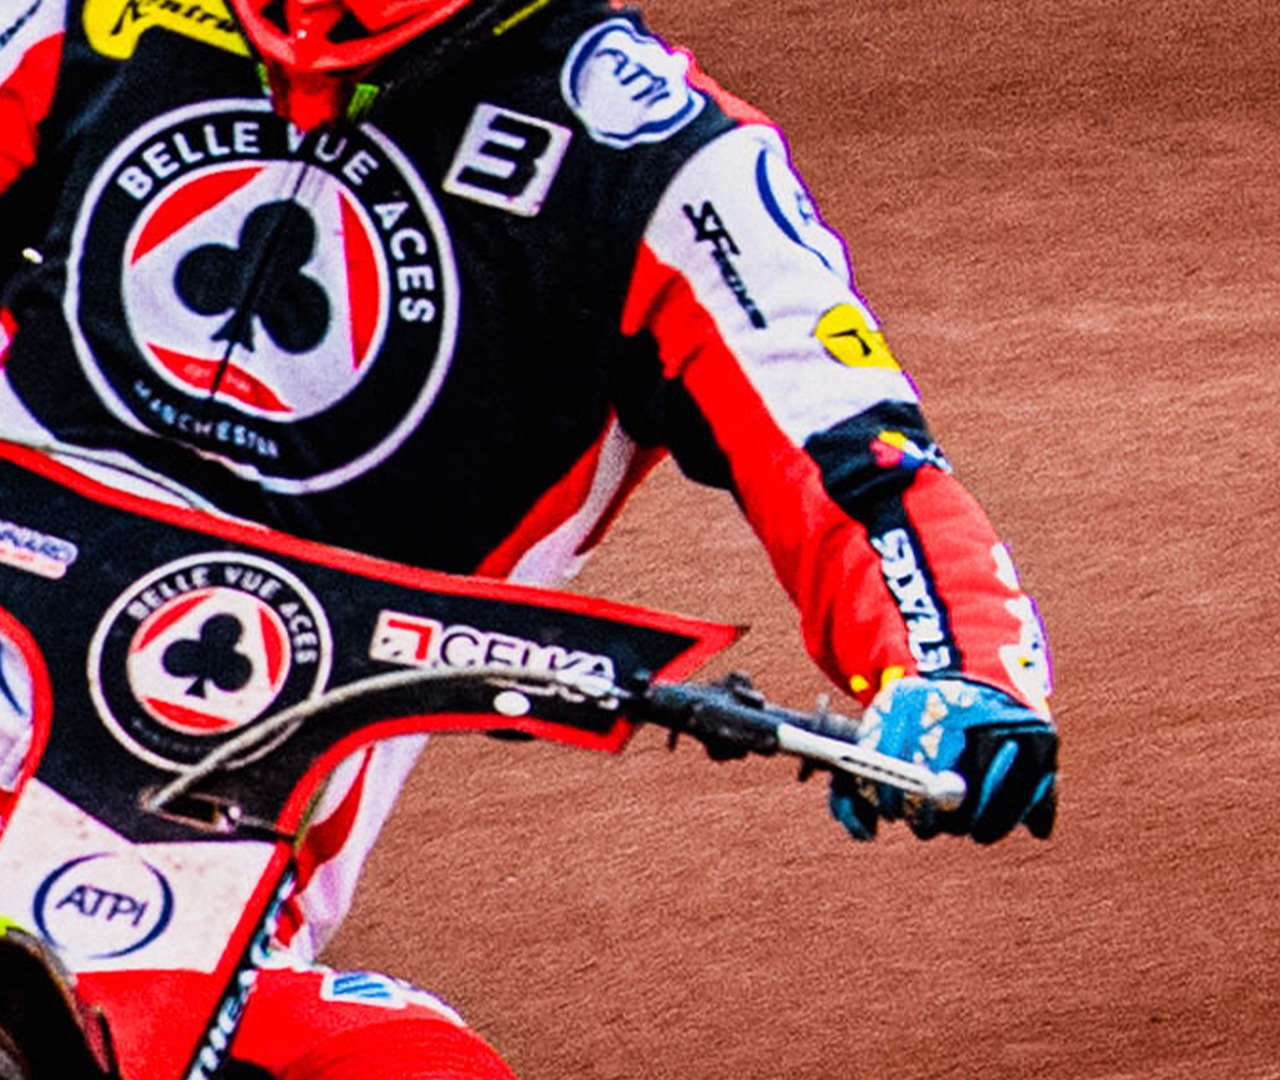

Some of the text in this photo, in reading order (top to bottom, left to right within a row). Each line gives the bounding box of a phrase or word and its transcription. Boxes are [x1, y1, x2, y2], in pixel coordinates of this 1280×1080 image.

[116, 121, 436, 323] BELLE VUE ACES
[126, 566, 319, 665] BELLE VUE ACES
[55, 884, 150, 928] ATPI
